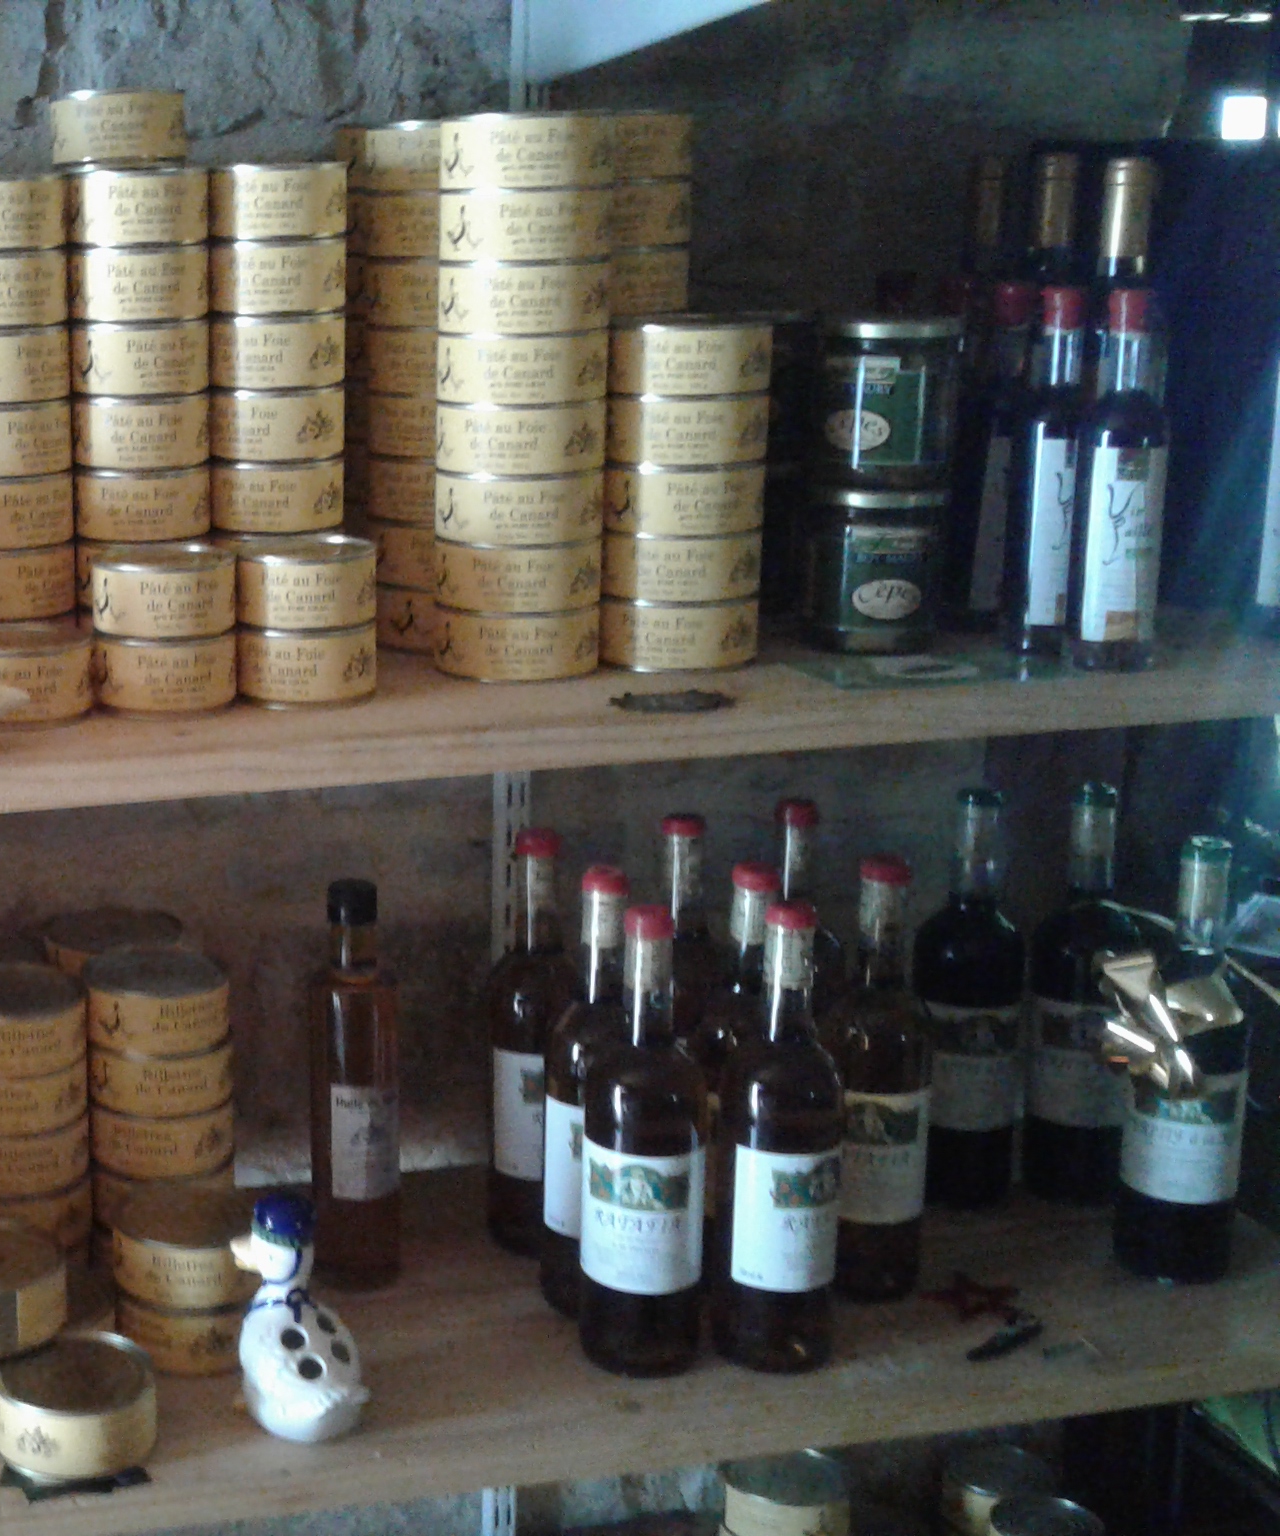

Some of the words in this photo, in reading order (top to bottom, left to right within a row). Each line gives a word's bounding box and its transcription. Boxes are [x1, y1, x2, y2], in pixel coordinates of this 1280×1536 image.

[490, 129, 519, 145] Pâté
[496, 148, 512, 161] de
[108, 184, 139, 199] Pâté
[143, 186, 160, 198] au
[254, 195, 304, 211] Canard
[500, 203, 529, 219] Pâté
[506, 222, 524, 234] de
[107, 262, 137, 278] Pâté
[133, 279, 181, 294] Canard
[252, 273, 302, 289] Canard
[126, 339, 154, 354] Pâté
[663, 357, 717, 371] Canard
[483, 366, 499, 380] de
[502, 364, 555, 379] Canard
[142, 415, 159, 426] au
[129, 428, 177, 443] Canard
[664, 427, 717, 441] Canard
[488, 436, 538, 450] Canard
[483, 490, 512, 505] Pâté
[490, 508, 505, 521] de
[472, 558, 499, 572] Pâté
[656, 565, 706, 578] Canard
[139, 580, 169, 596] Pâté
[478, 577, 493, 588] de
[497, 575, 546, 588] Canard
[146, 599, 163, 612] de
[167, 596, 214, 611] Canard
[284, 590, 336, 603] Canard
[479, 626, 507, 640] Pâté
[644, 632, 696, 645] Canard
[137, 654, 167, 669] Pâté
[268, 663, 317, 678] Canard
